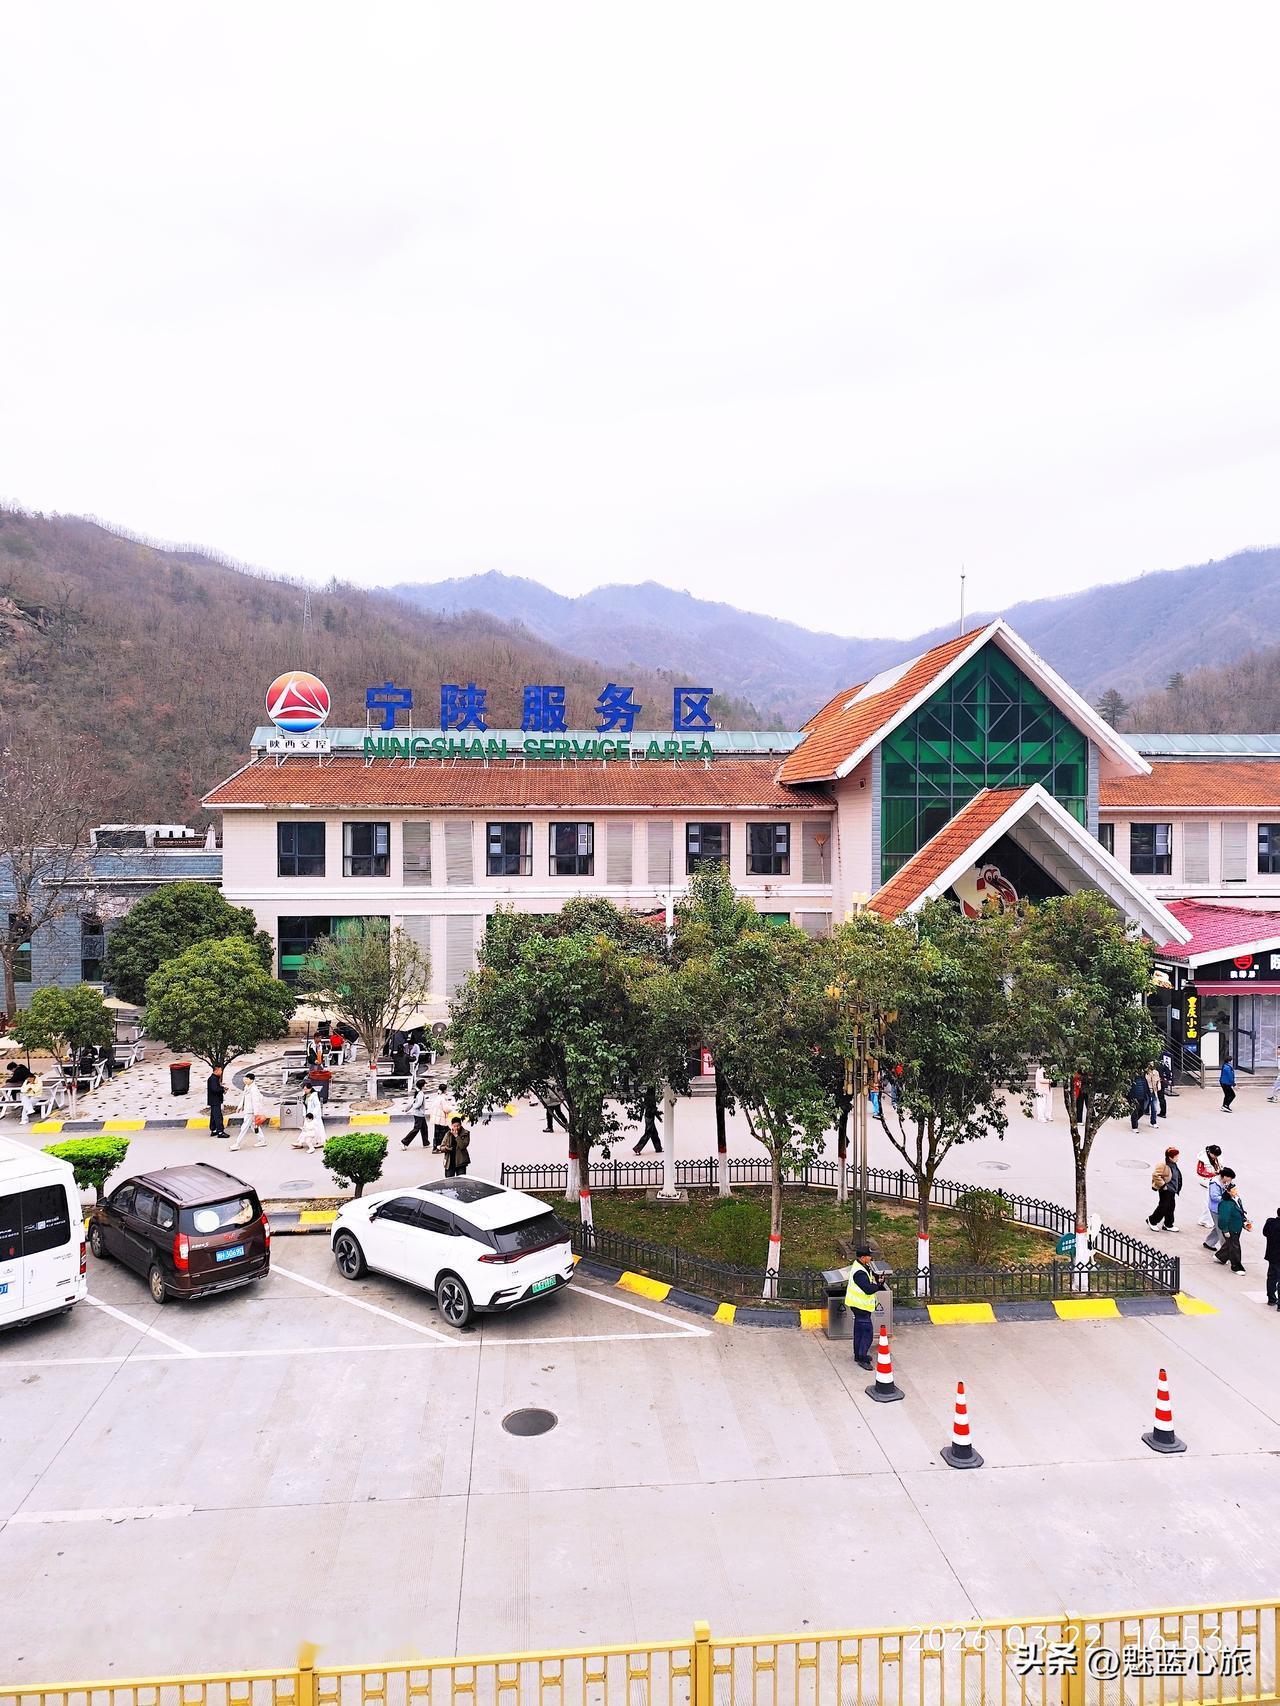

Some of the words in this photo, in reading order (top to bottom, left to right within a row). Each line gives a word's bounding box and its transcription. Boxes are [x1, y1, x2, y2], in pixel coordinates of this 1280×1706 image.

[366, 681, 716, 733] 宁陕服务区
[363, 736, 507, 760] NINGSHAN
[522, 738, 631, 760] SERVICE
[645, 739, 715, 761] AREA
